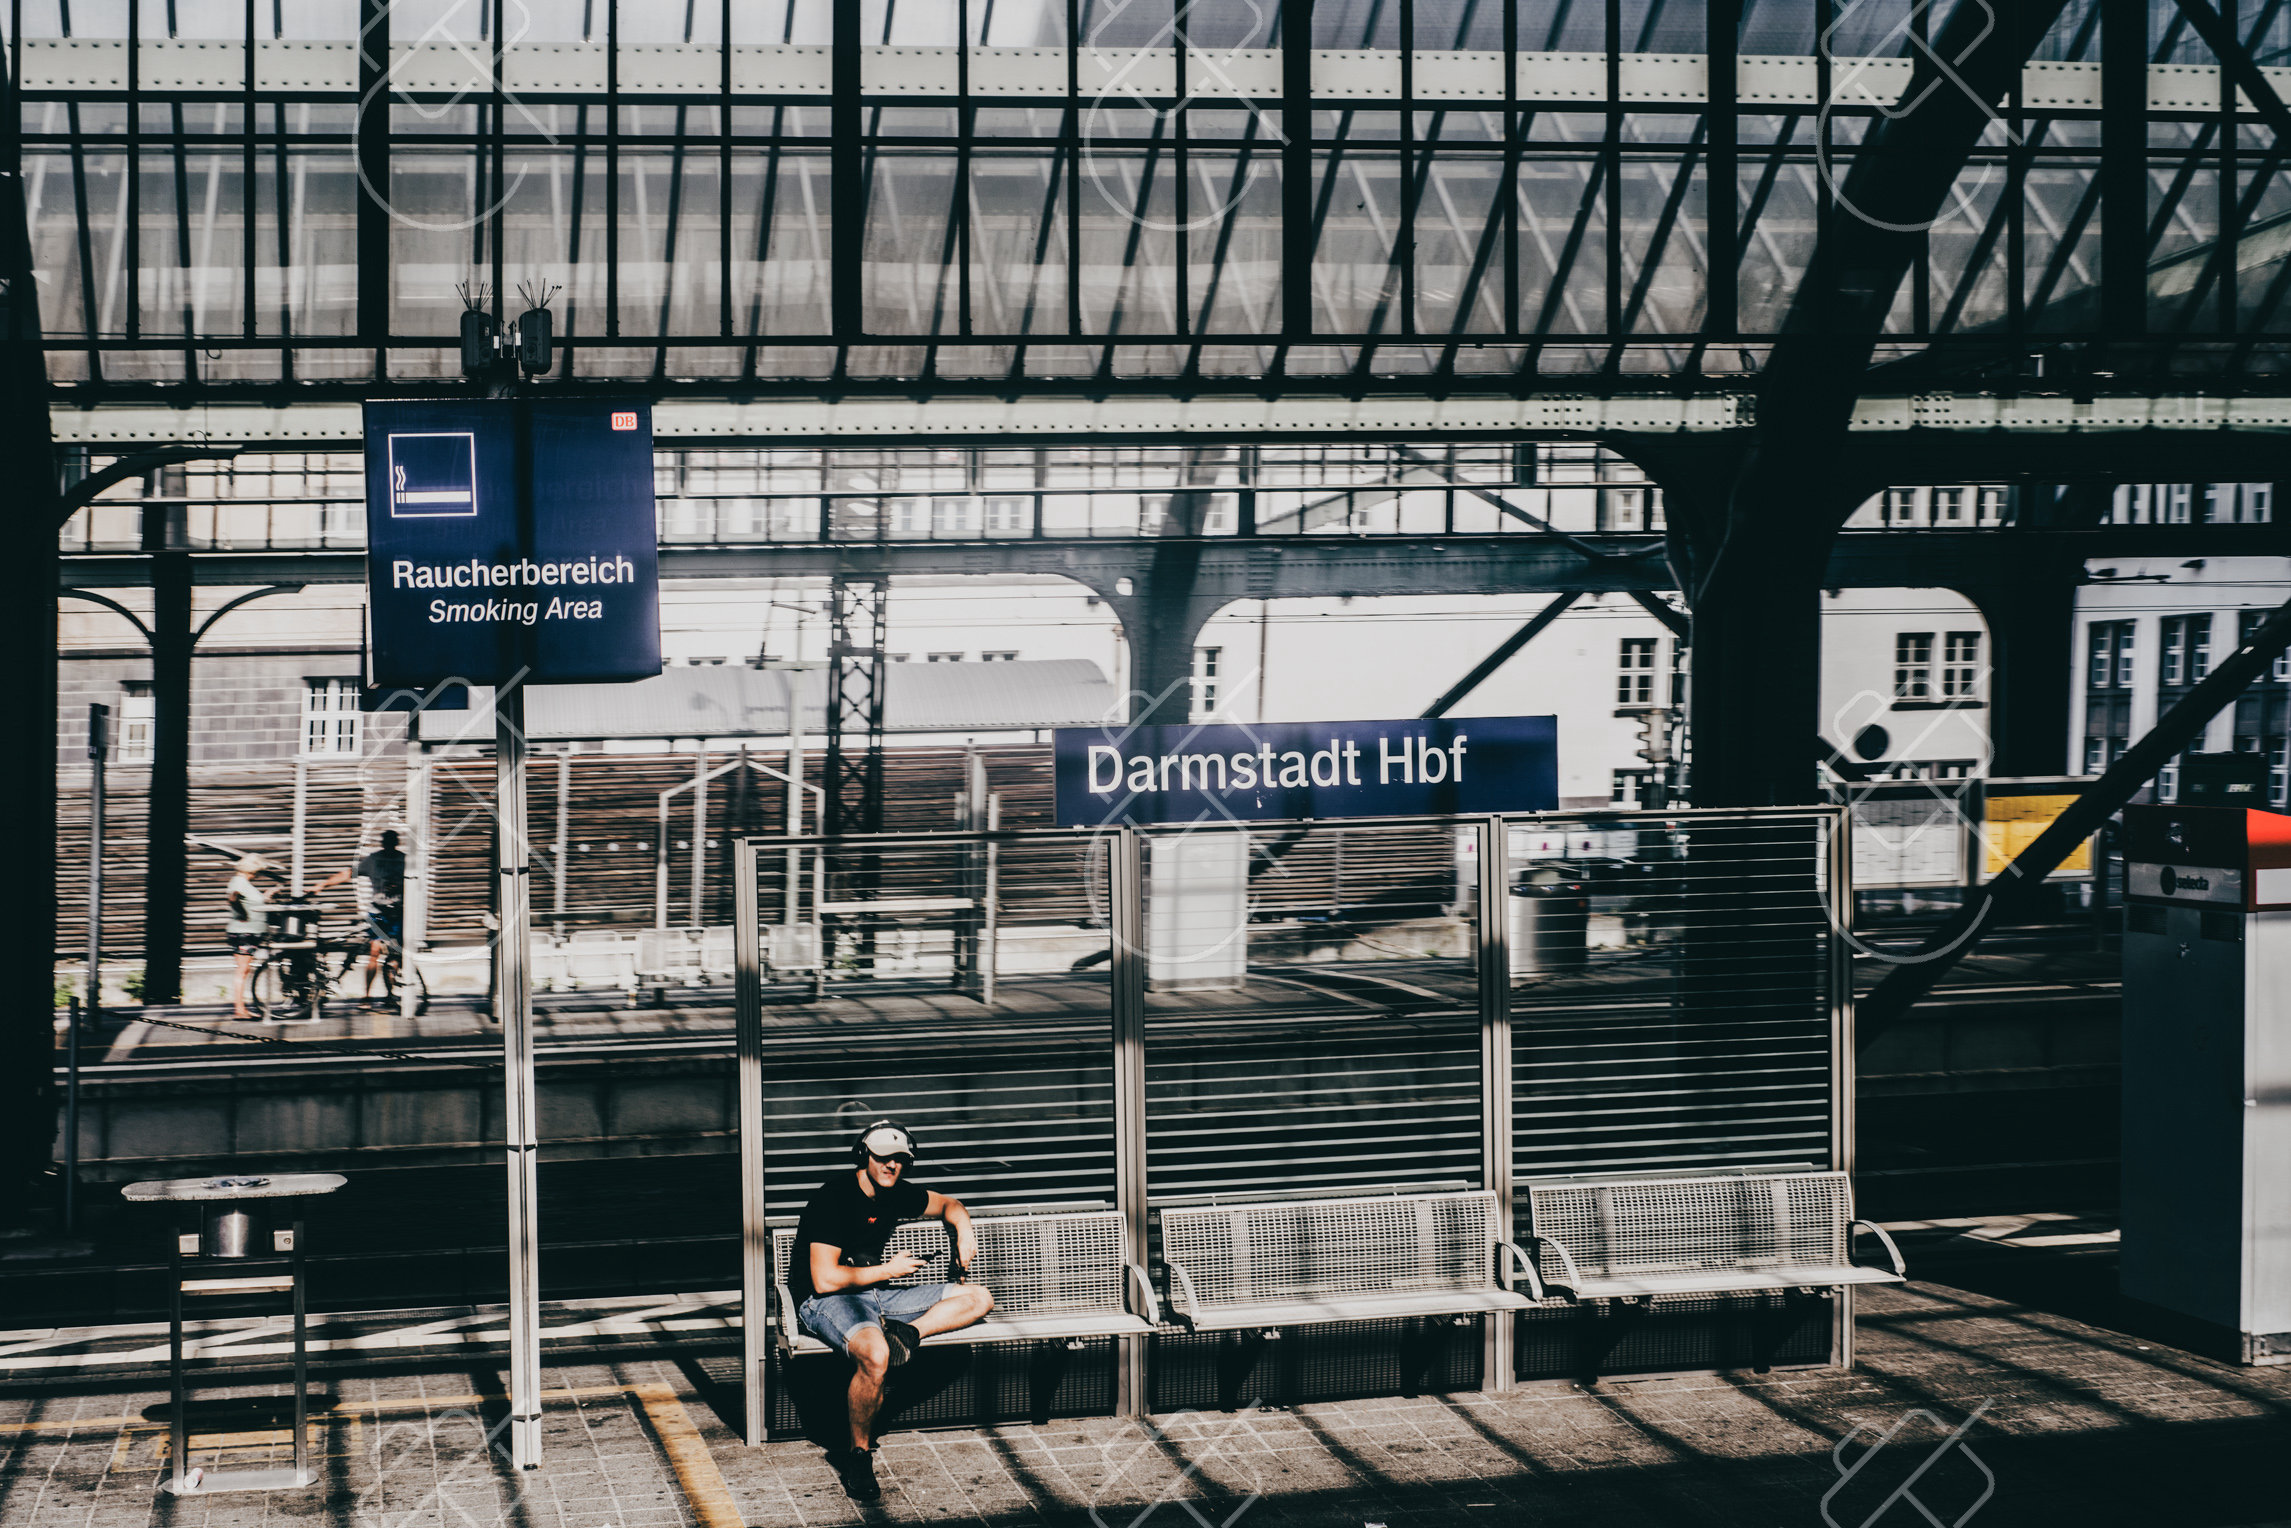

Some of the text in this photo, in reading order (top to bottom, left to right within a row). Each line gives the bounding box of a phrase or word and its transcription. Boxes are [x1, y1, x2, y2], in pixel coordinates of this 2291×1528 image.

[613, 414, 636, 429] DB
[393, 556, 634, 588] Raucherbereich
[428, 597, 603, 625] Smoking Area
[1088, 735, 1468, 793] Darmstadt Hbf
